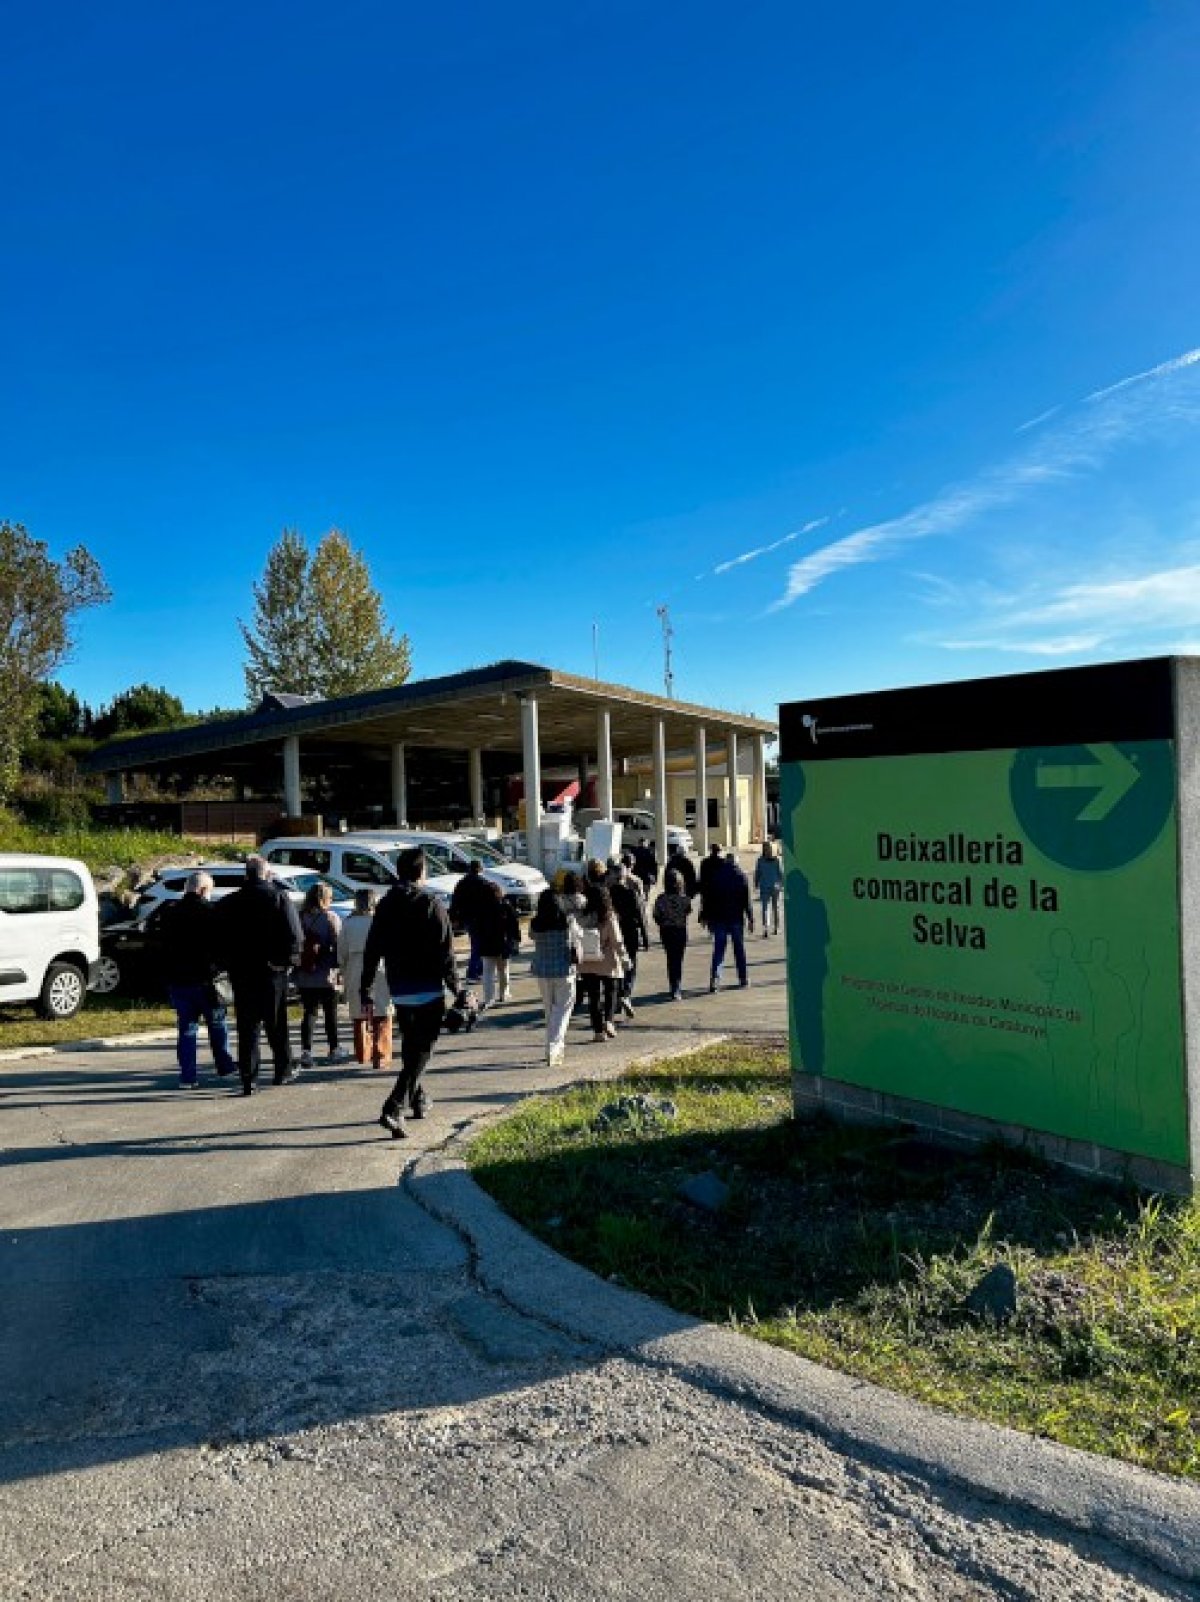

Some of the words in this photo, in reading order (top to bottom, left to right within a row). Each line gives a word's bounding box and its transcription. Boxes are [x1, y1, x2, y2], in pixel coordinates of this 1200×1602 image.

[877, 832, 1023, 865] Deixalleria
[853, 876, 971, 906] comarcal
[984, 877, 1017, 909] de
[1030, 879, 1058, 912] la
[912, 913, 986, 950] Selva
